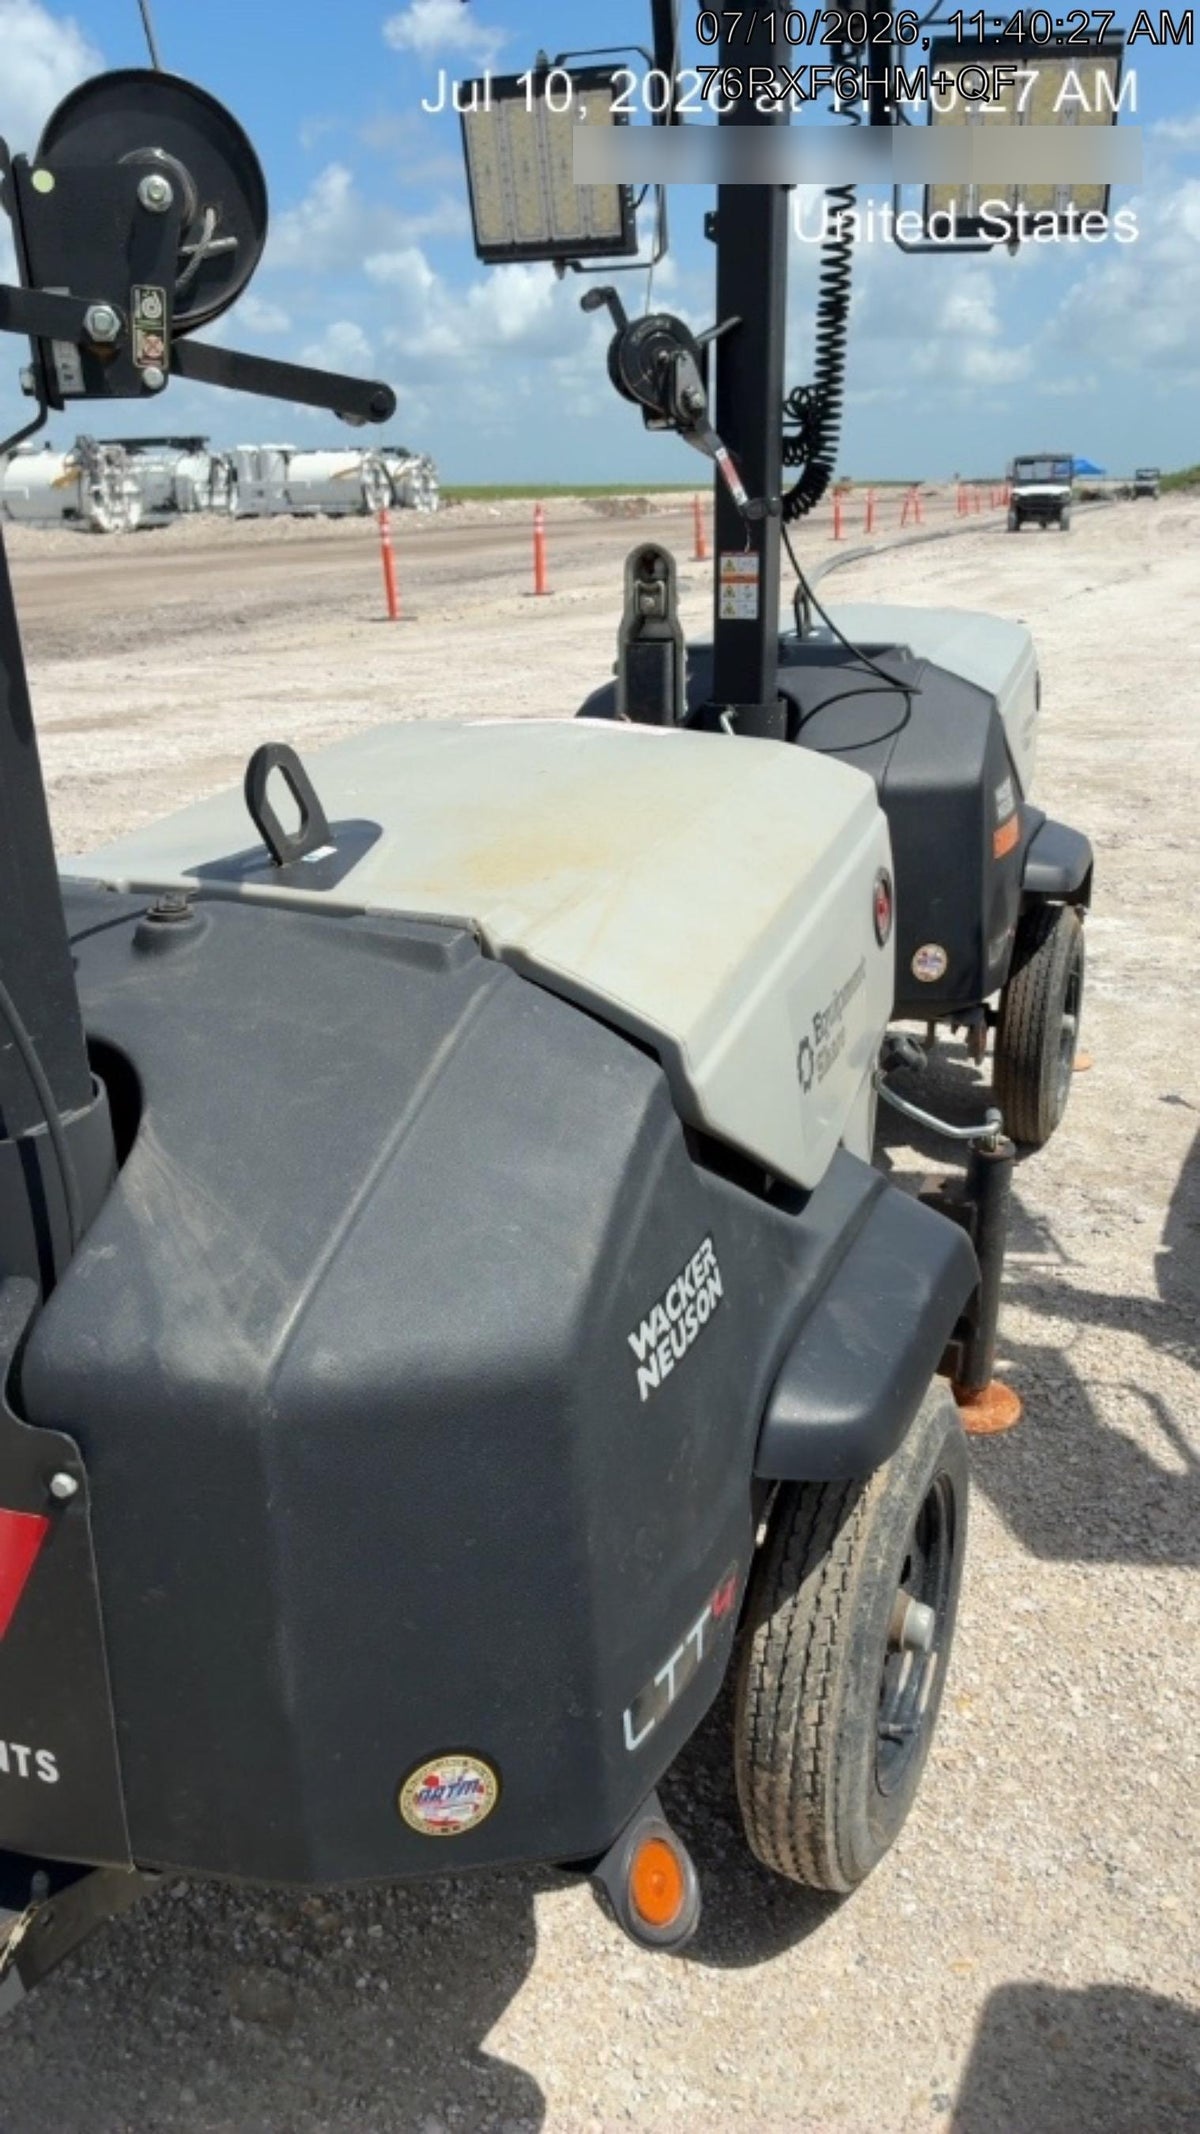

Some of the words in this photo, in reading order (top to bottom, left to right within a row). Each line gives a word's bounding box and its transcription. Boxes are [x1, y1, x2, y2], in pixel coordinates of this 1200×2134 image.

[627, 1236, 718, 1362] WACKER
[636, 1267, 724, 1402] NEUSON
[622, 1576, 737, 1752] LTT4
